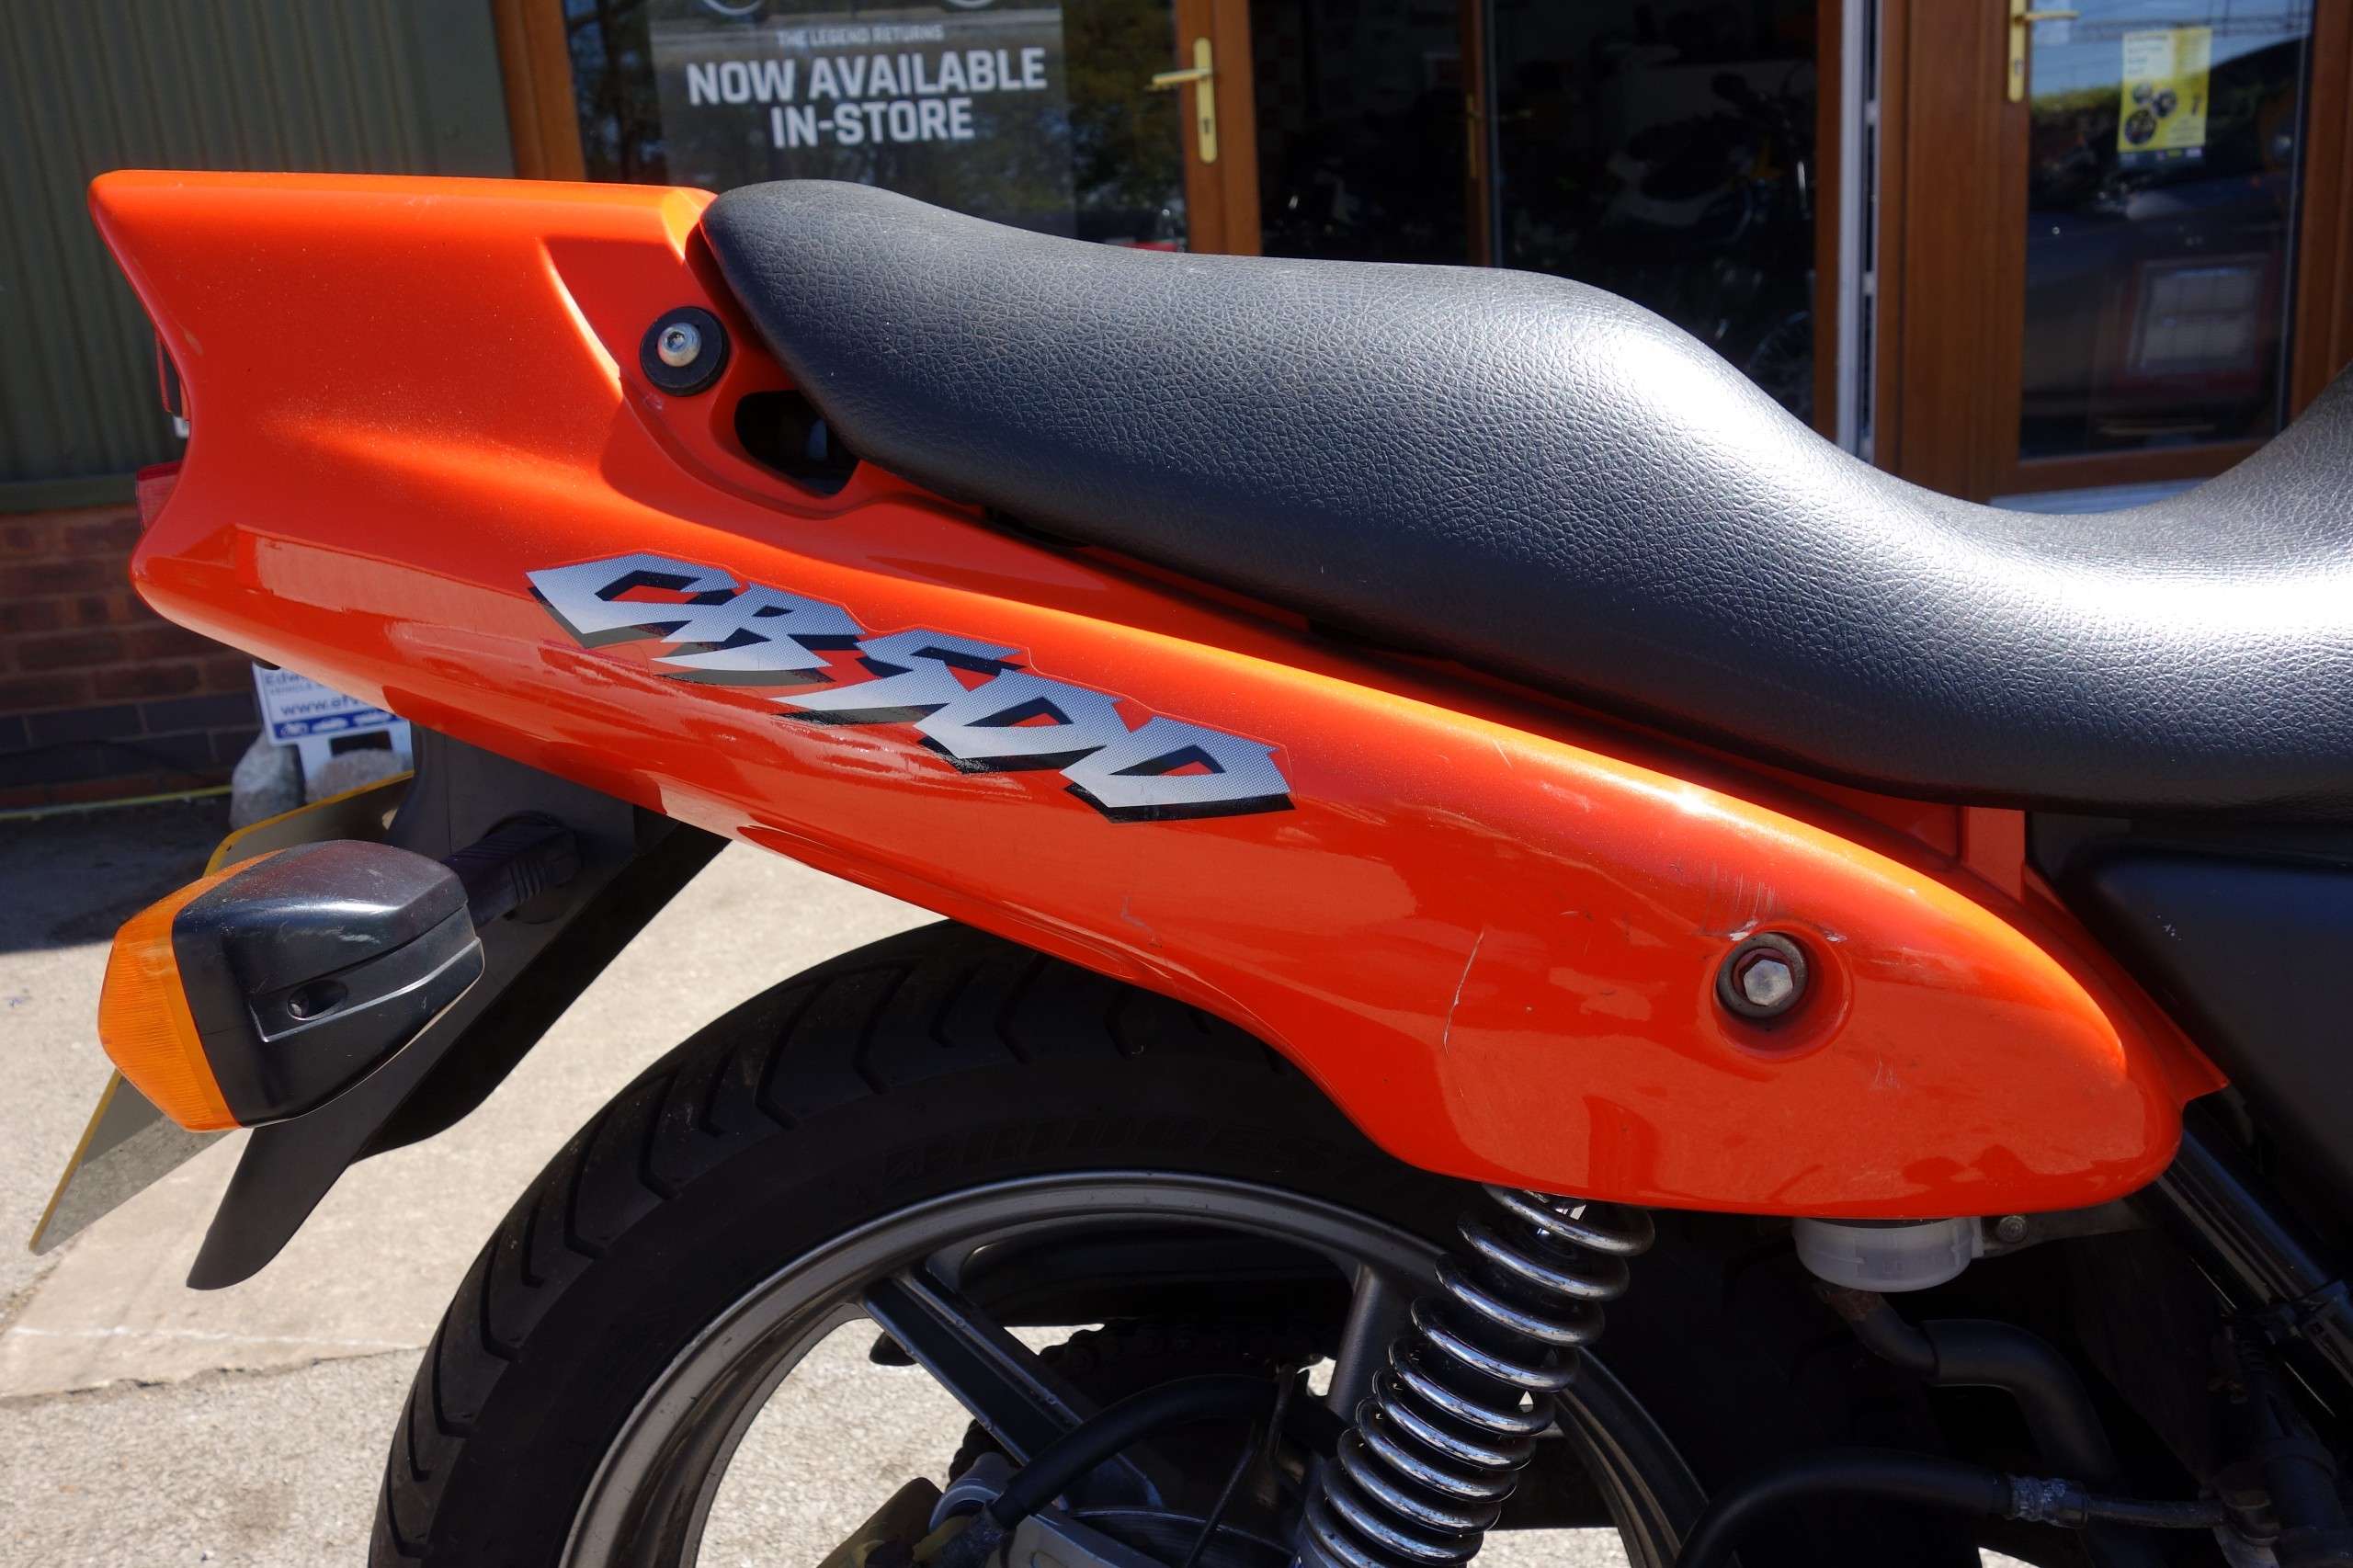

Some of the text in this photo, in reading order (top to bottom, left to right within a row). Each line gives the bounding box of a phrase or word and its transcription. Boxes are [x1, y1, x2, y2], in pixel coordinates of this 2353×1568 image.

[777, 25, 944, 48] THE LEGEND RETURNS
[687, 48, 1047, 105] NOW AVAILABLE
[772, 98, 974, 149] IN-STORE
